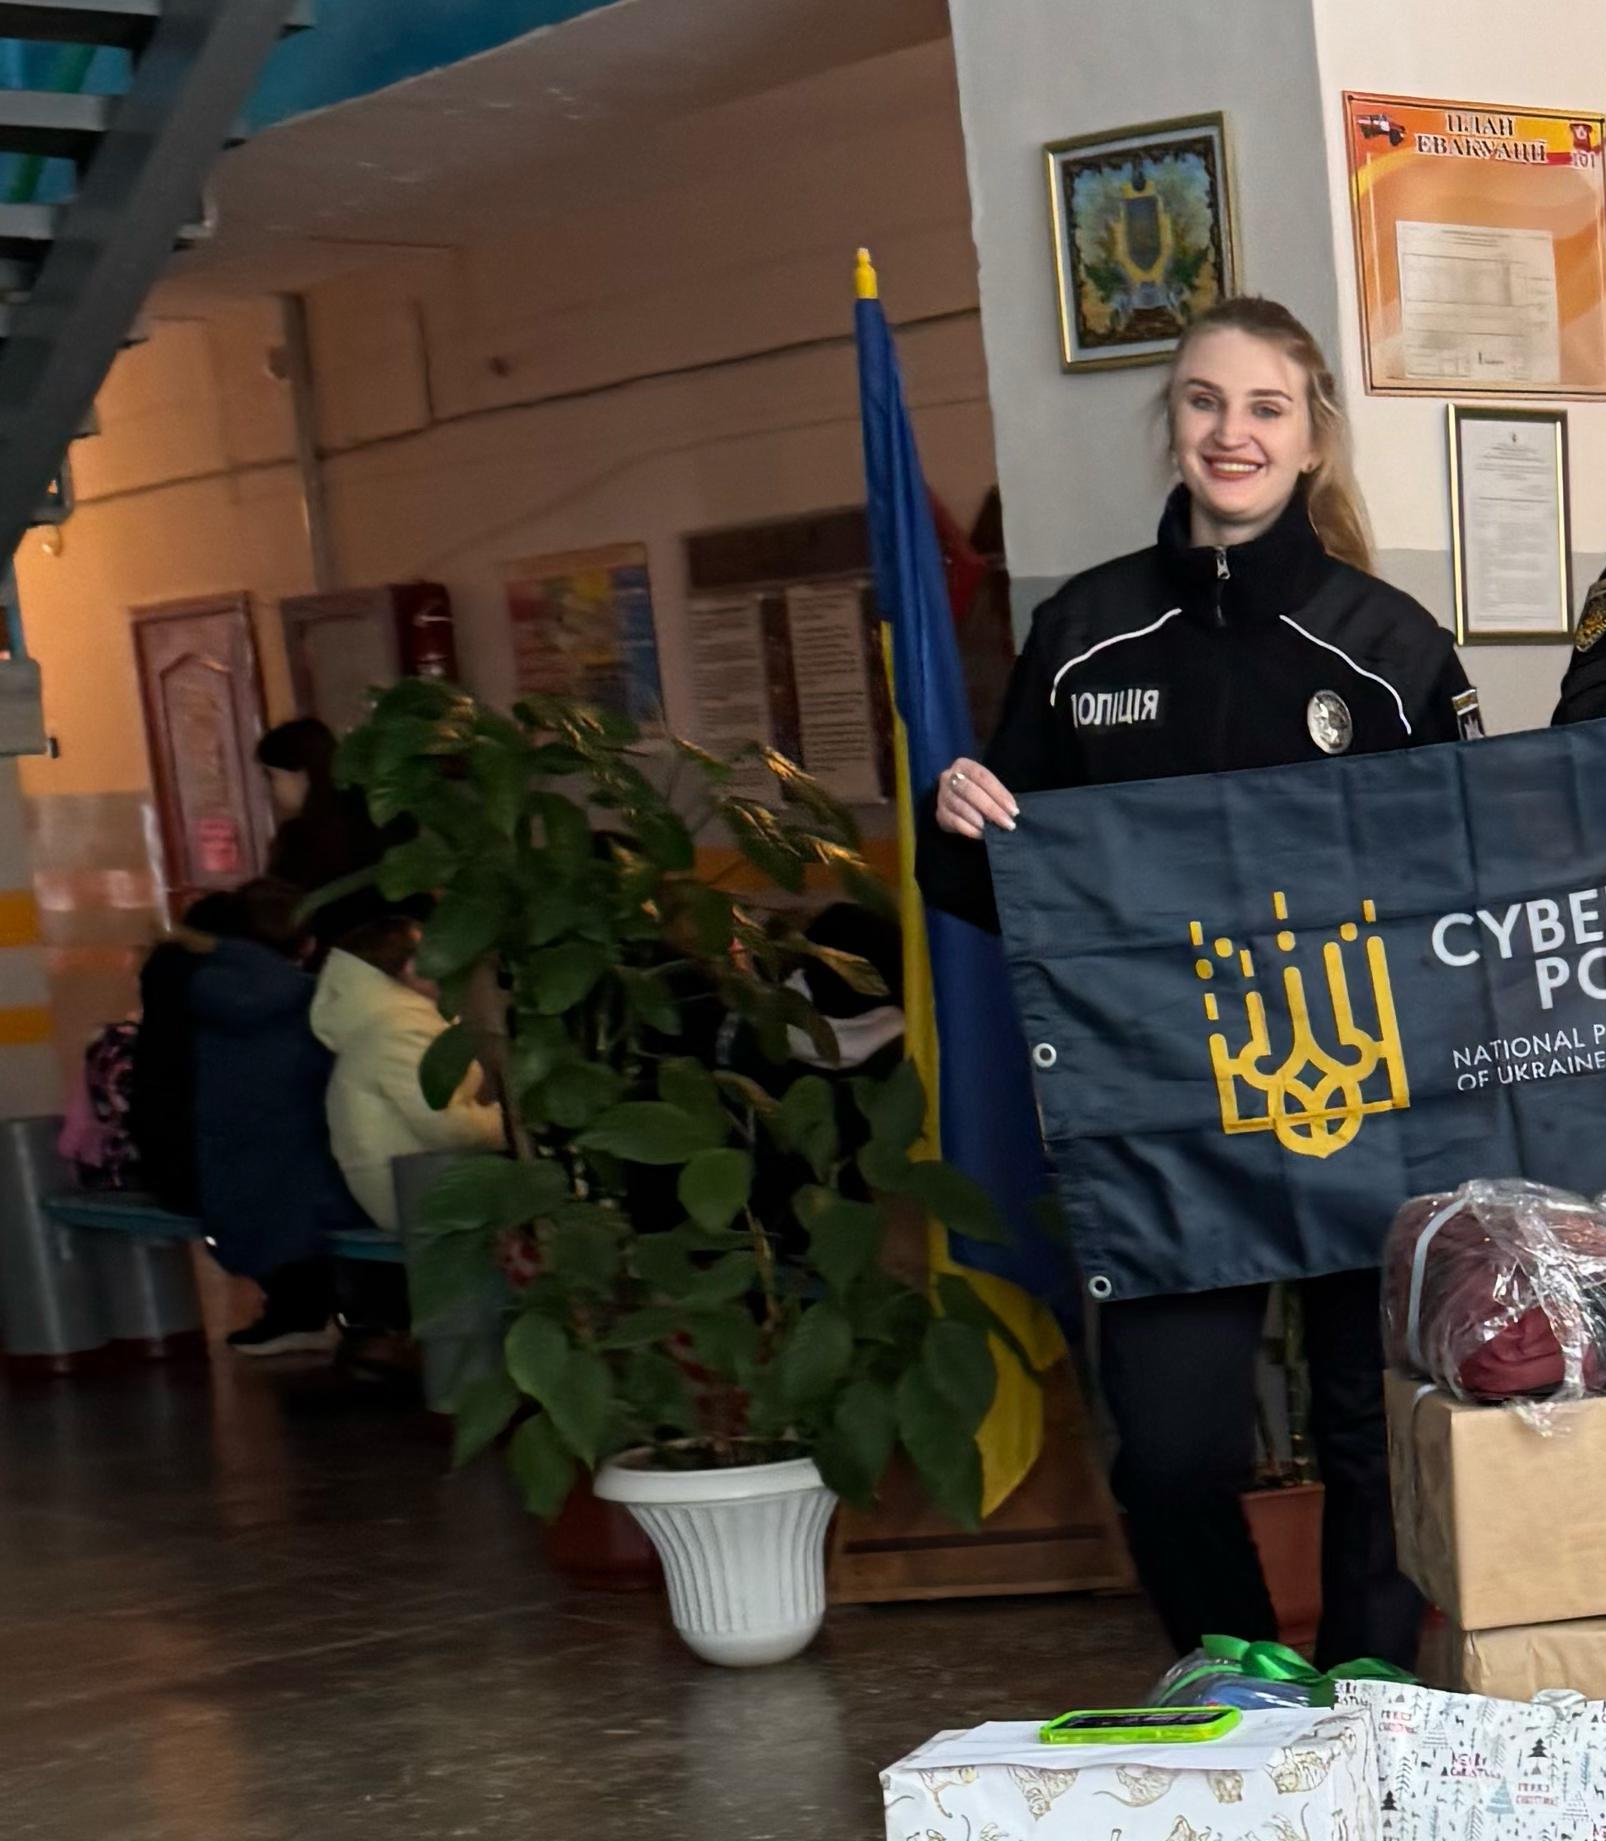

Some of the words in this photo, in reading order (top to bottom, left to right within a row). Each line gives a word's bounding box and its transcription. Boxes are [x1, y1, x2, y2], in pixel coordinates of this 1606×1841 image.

[1446, 114, 1515, 136] ПЛАН
[1452, 1027, 1586, 1069] NATIONAL
[1457, 1070, 1490, 1092] OF
